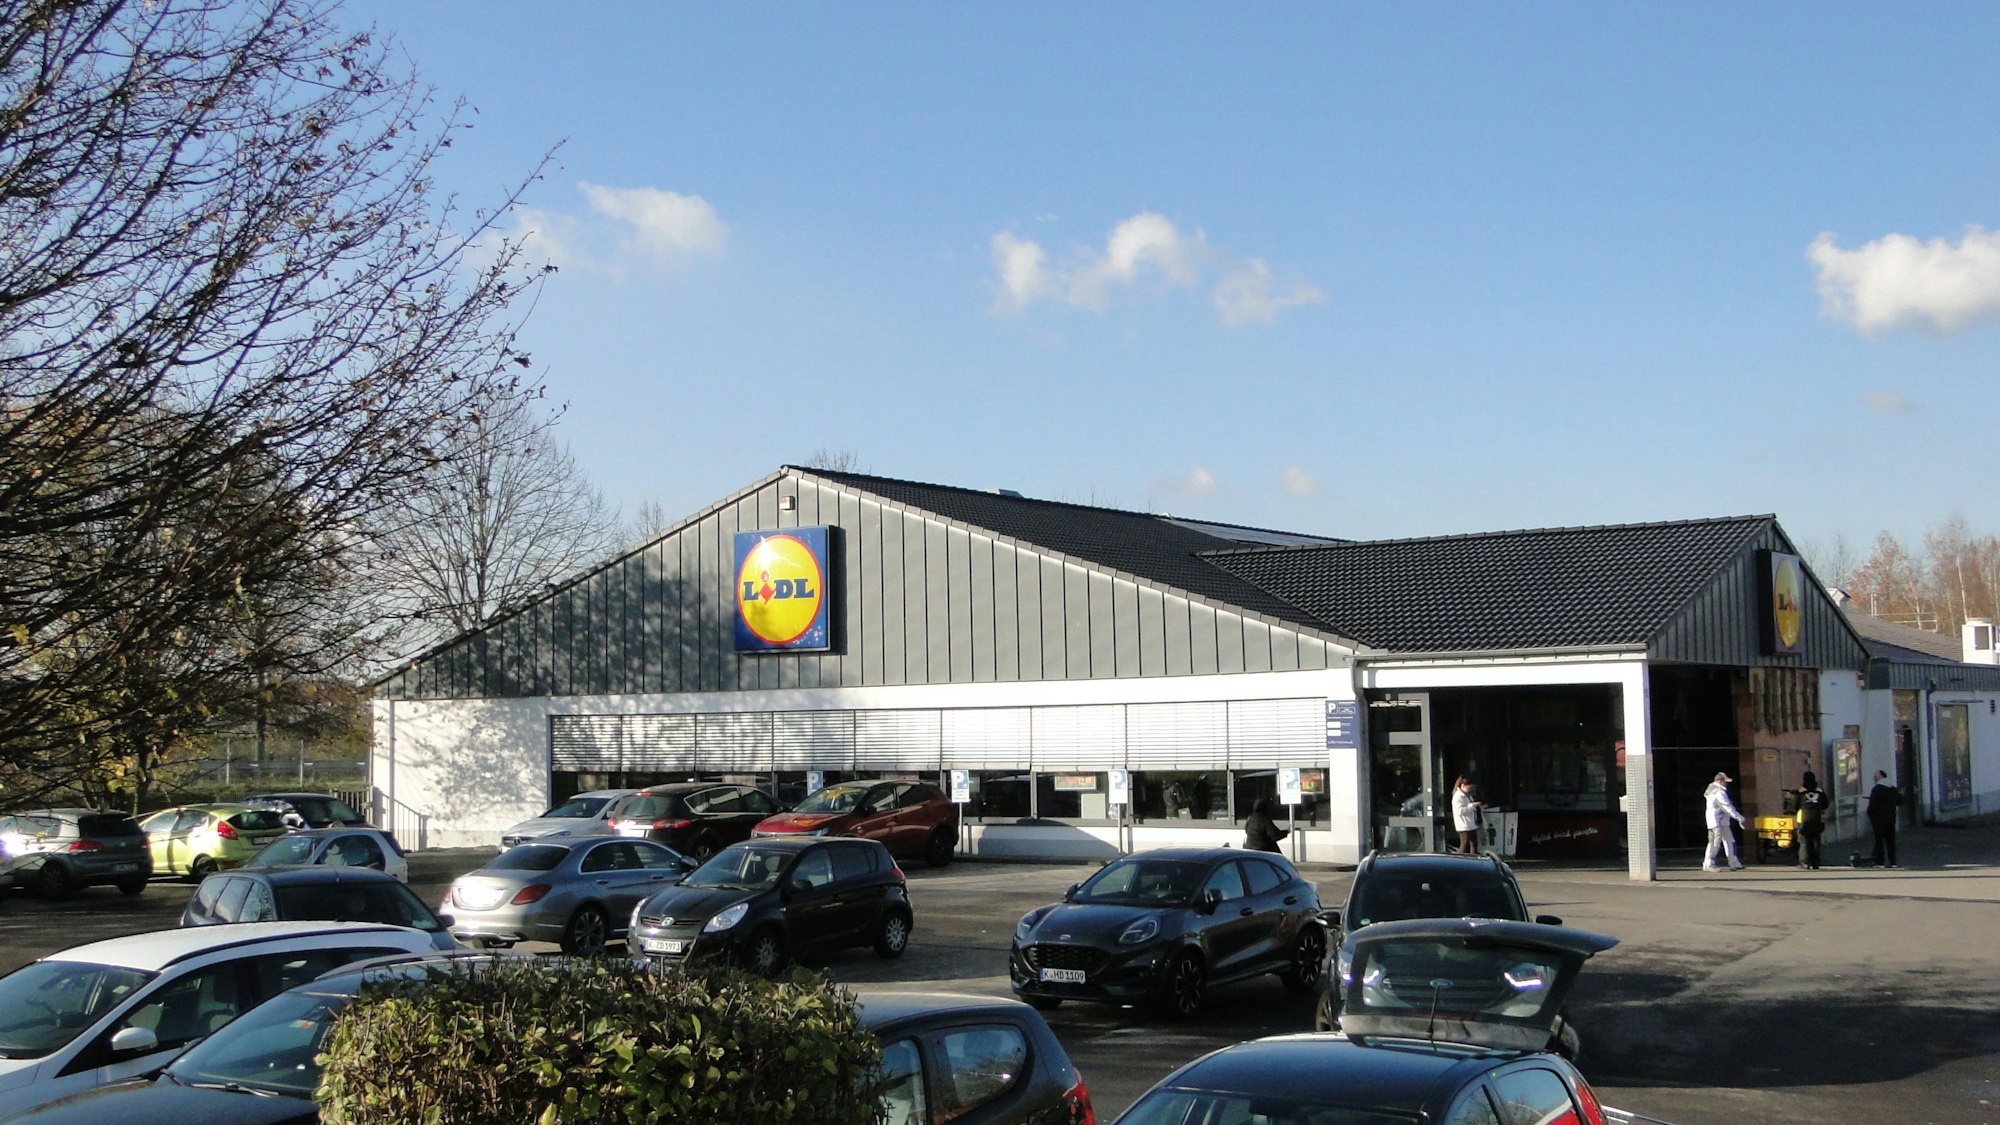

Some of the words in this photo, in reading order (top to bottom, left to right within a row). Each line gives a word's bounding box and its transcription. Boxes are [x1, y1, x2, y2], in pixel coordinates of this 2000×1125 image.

[808, 772, 819, 789] P
[952, 771, 965, 789] P
[1109, 771, 1122, 789] P
[1280, 770, 1295, 789] P
